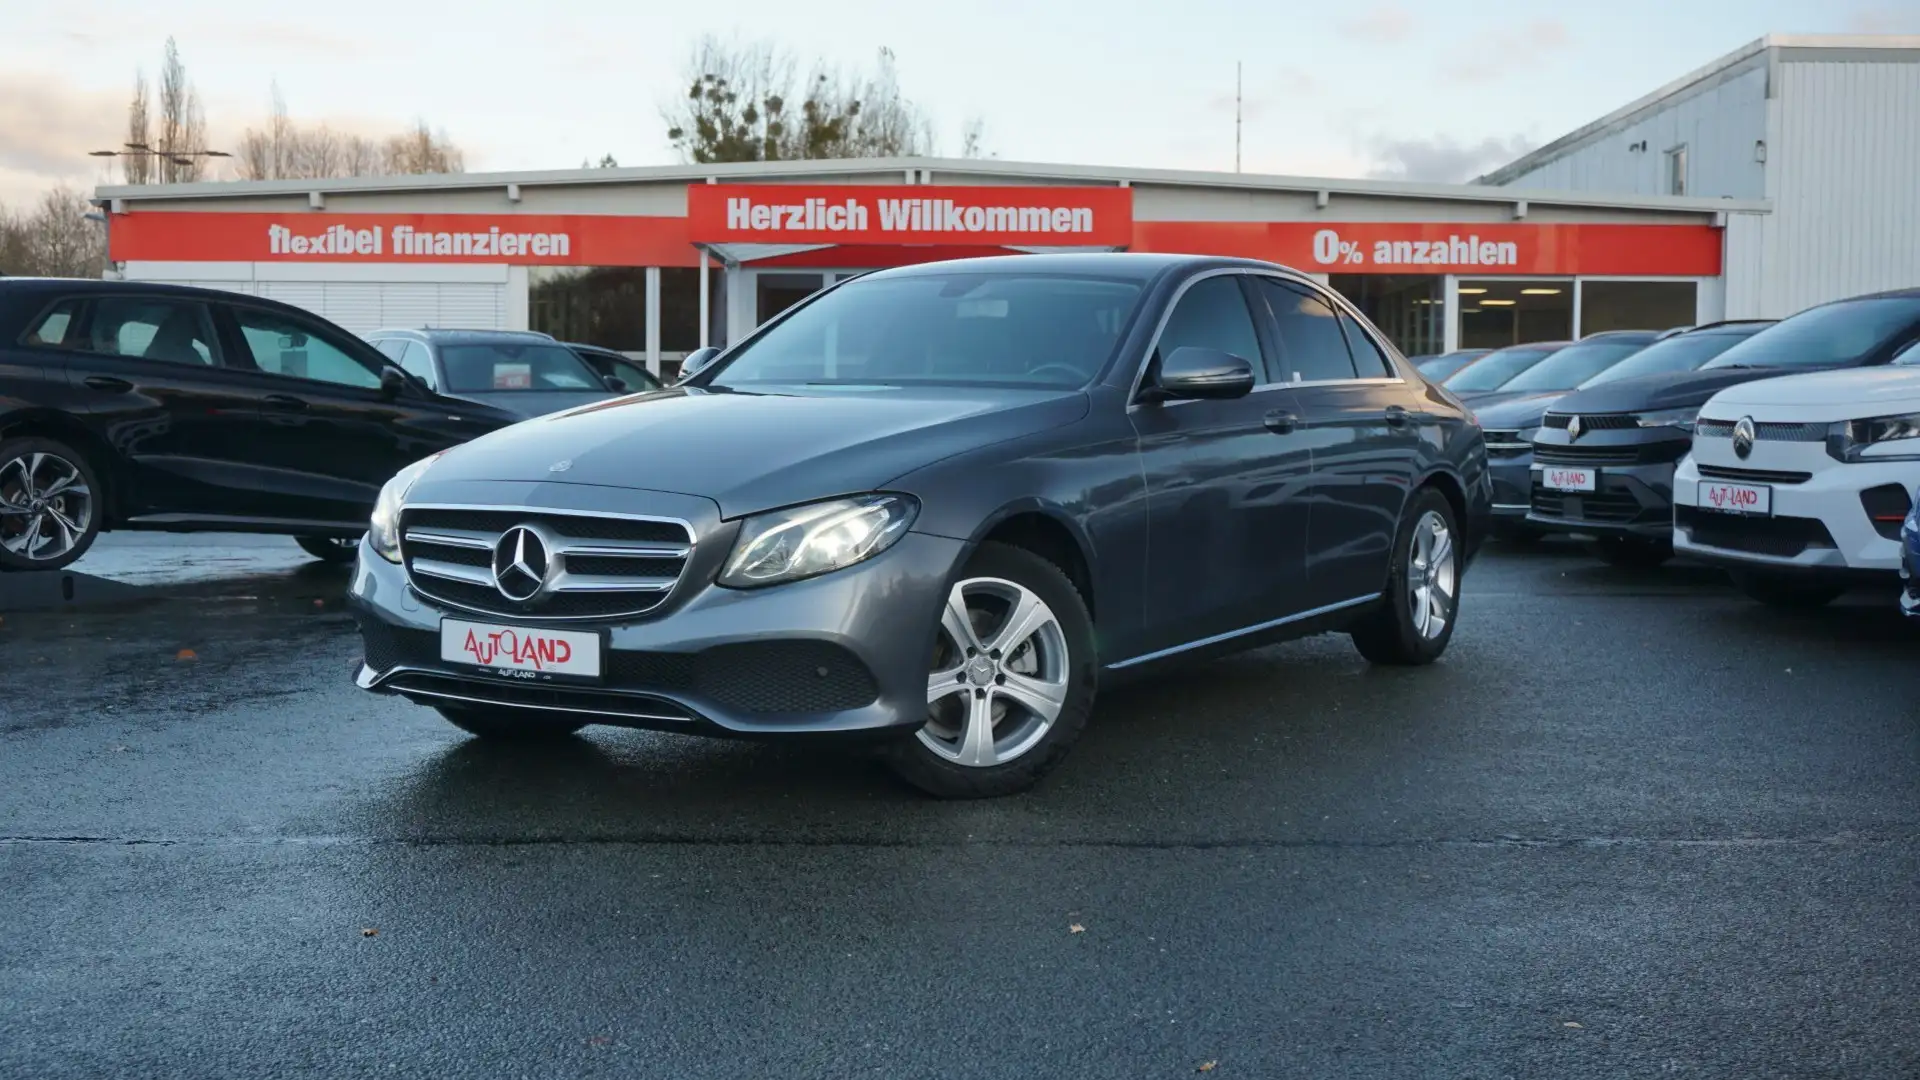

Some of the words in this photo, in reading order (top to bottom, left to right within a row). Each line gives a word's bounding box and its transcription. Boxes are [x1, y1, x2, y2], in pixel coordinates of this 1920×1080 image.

[727, 197, 867, 231] Herzlich
[878, 198, 1093, 233] Willkommen
[268, 224, 382, 254] flexibel
[391, 226, 570, 256] finanzieren
[1312, 229, 1364, 265] 0%
[1373, 234, 1518, 265] anzahlen
[464, 627, 571, 670] AUTOLAND
